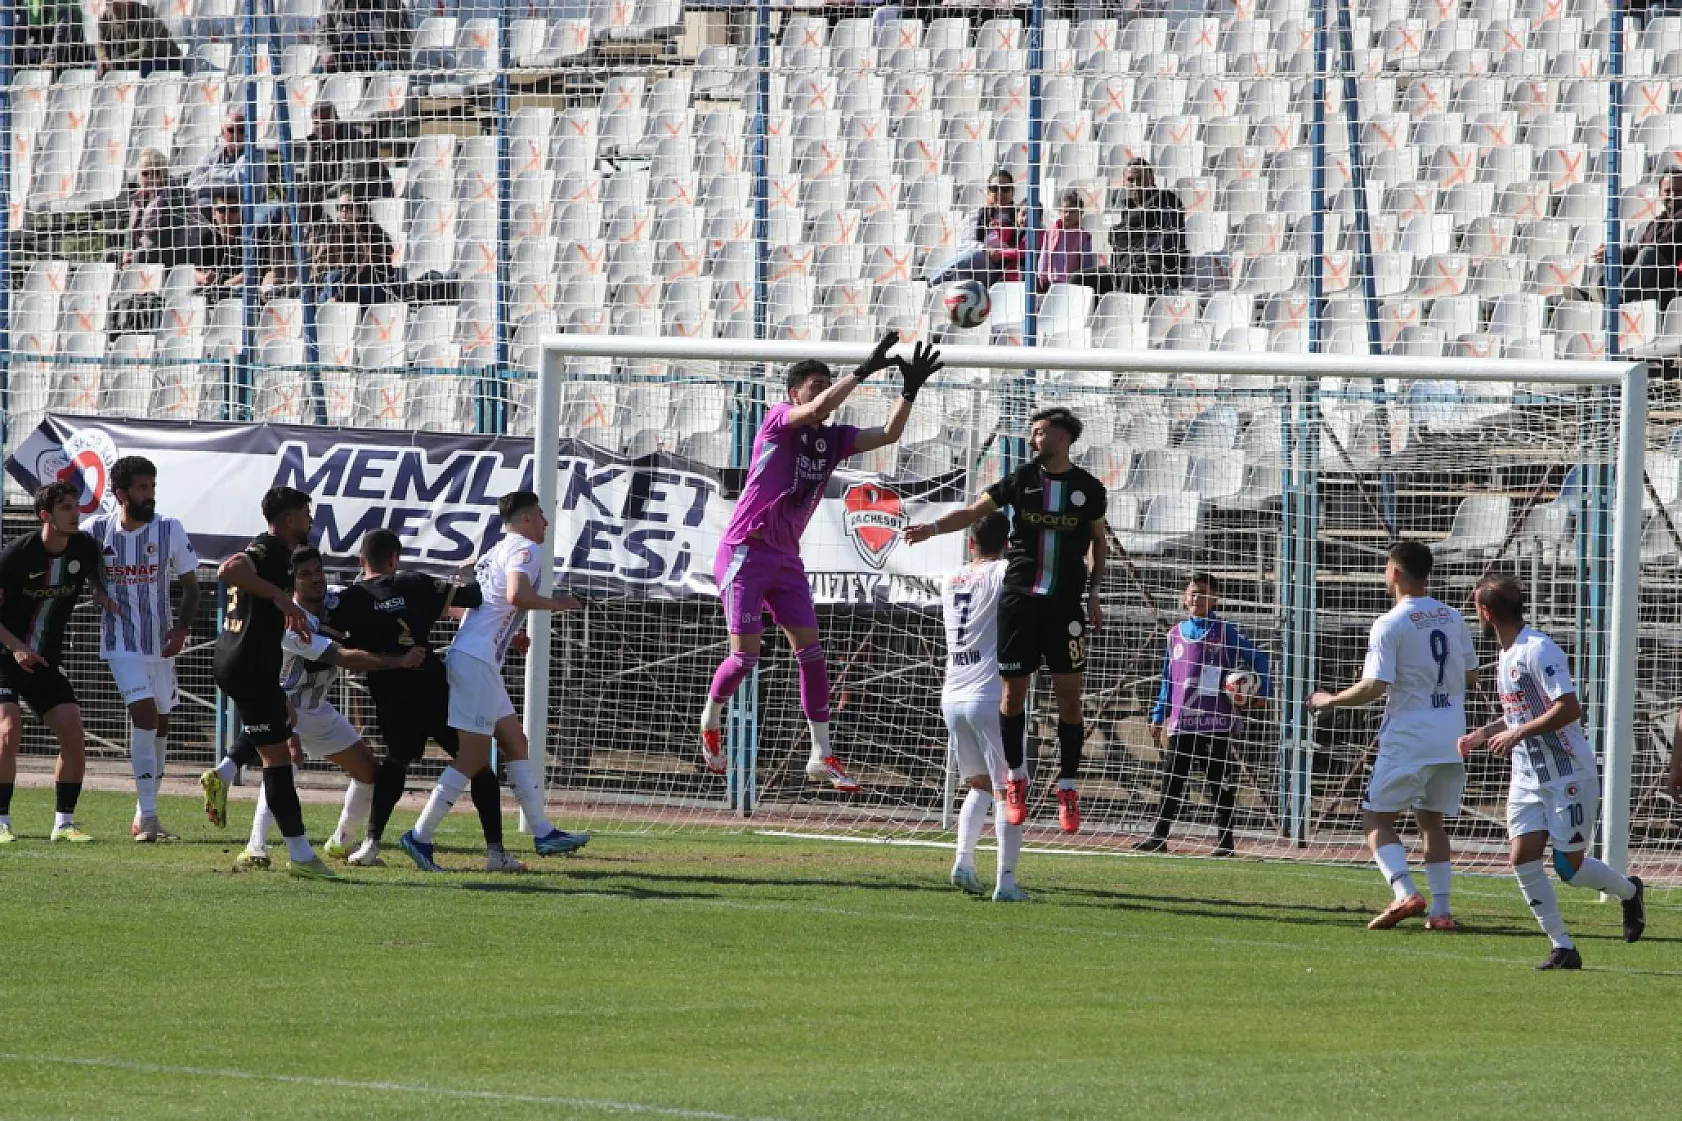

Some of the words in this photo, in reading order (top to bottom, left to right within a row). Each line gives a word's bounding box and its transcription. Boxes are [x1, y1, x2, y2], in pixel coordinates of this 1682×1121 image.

[105, 564, 158, 577] ESNAF
[953, 593, 971, 646] 7
[1430, 629, 1449, 686] 9
[1567, 802, 1584, 828] 10
